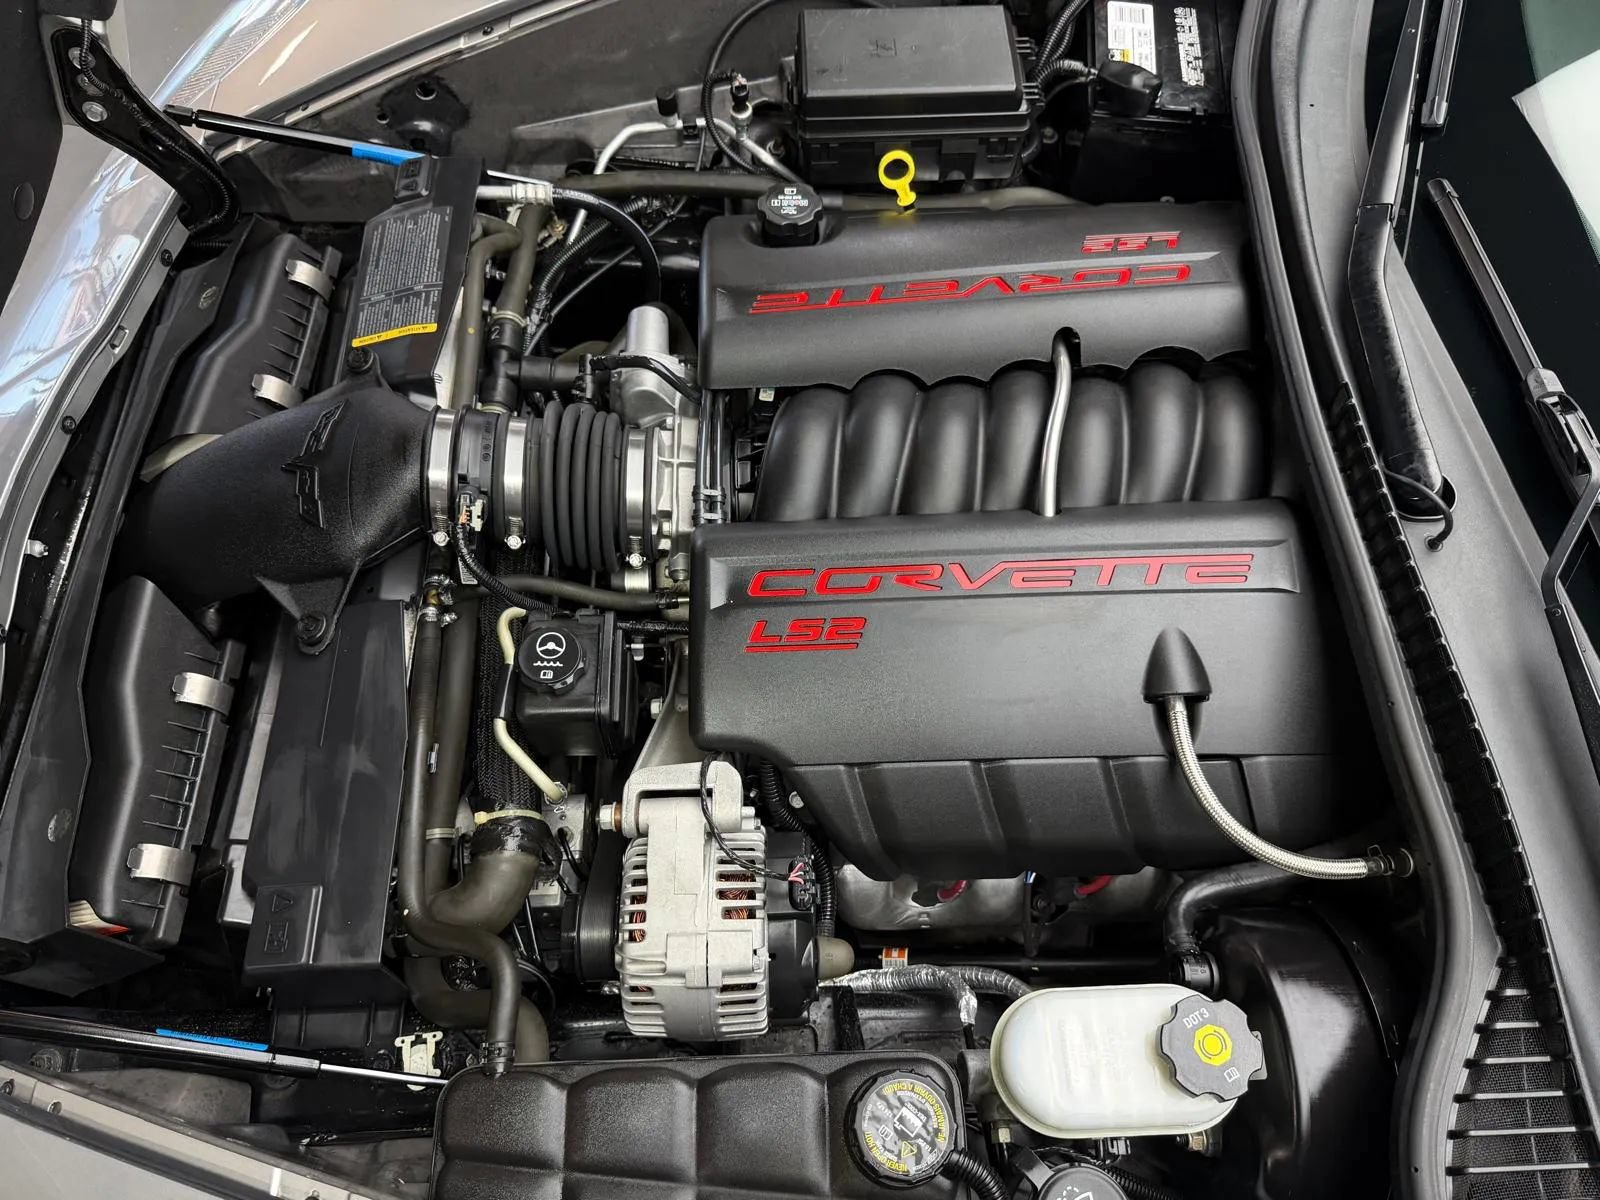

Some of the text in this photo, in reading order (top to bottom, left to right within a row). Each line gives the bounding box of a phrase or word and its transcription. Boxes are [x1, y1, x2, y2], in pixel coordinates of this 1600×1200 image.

[1080, 230, 1182, 254] LS2
[748, 263, 1192, 315] CORVETTE
[747, 553, 1254, 599] CORVETTE
[744, 616, 868, 651] LS2
[1183, 1007, 1210, 1029] DOT 3
[913, 1083, 937, 1105] OUVRIR
[932, 1101, 946, 1129] JAMAIS
[864, 1131, 875, 1148] HOT!
[870, 1145, 887, 1165] OPEN
[884, 1158, 907, 1172] NEVER
